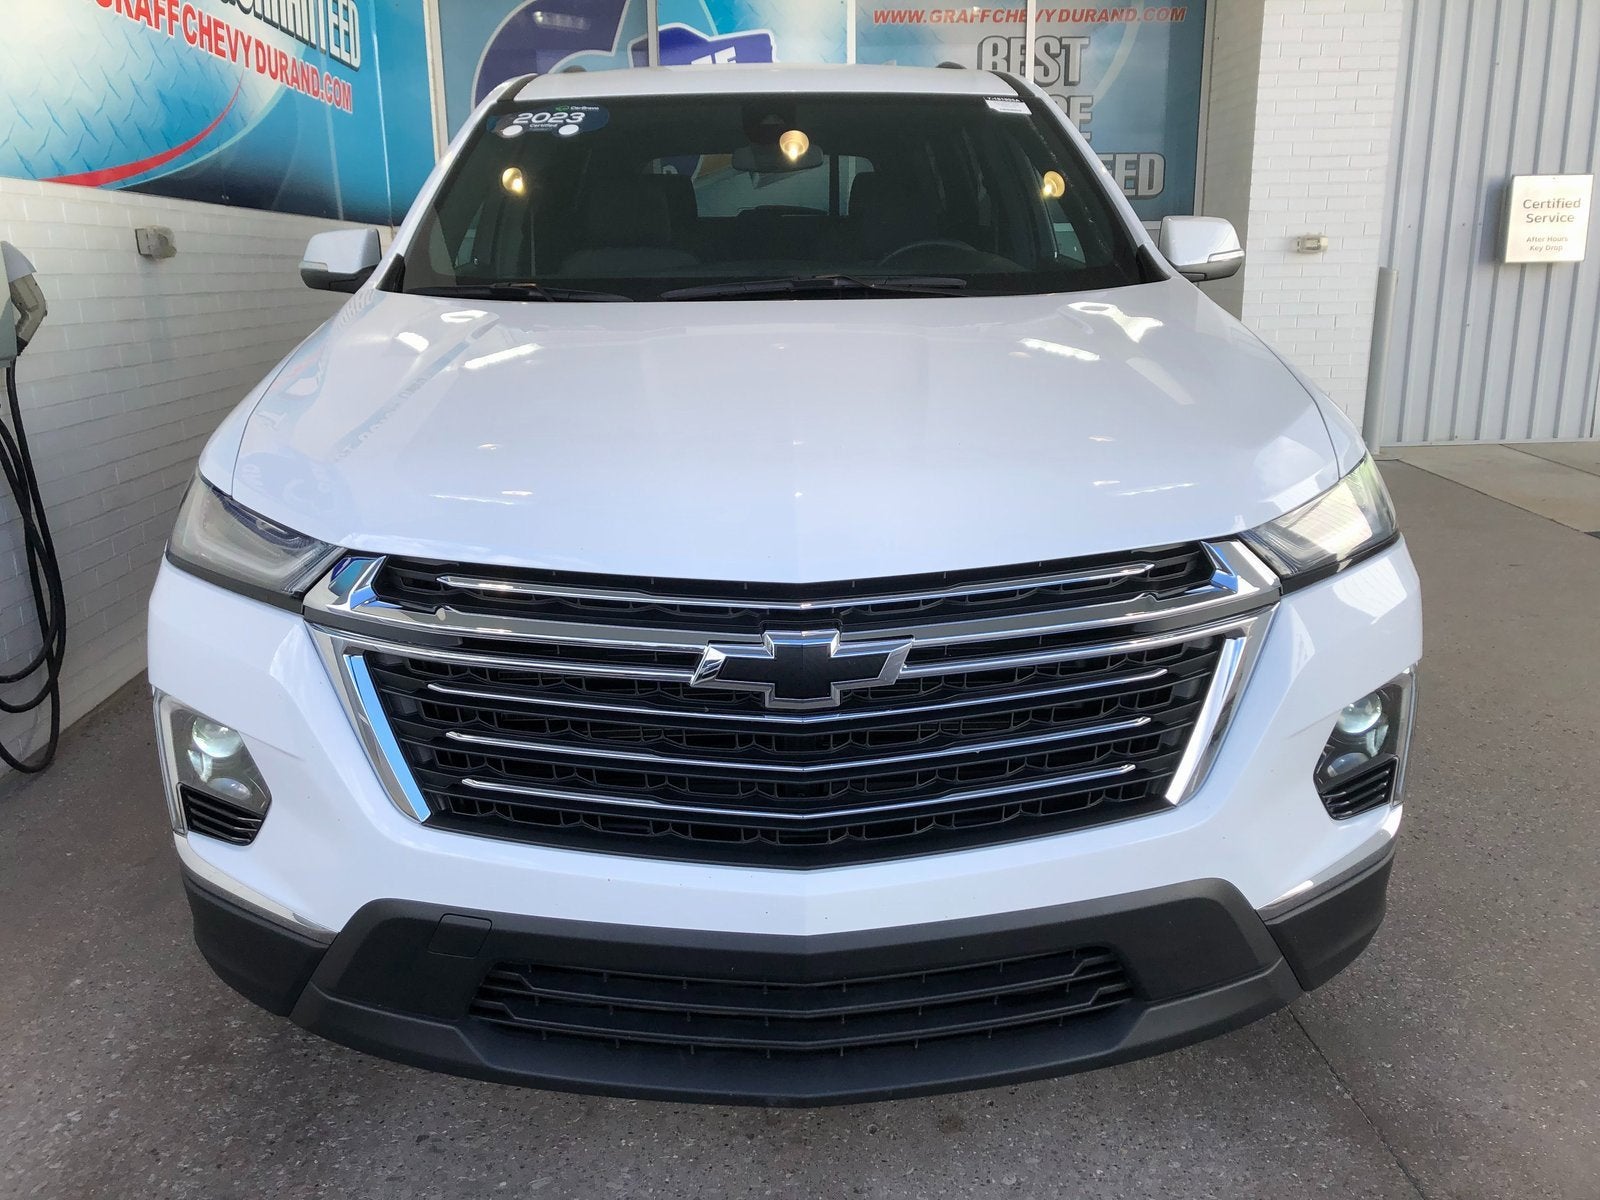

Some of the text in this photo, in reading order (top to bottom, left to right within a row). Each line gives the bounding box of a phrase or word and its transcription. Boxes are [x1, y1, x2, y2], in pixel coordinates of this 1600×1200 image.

[513, 111, 586, 124] 2023
[1522, 198, 1582, 210] Certified
[1525, 212, 1575, 223] Service
[1545, 244, 1563, 252] Drop
